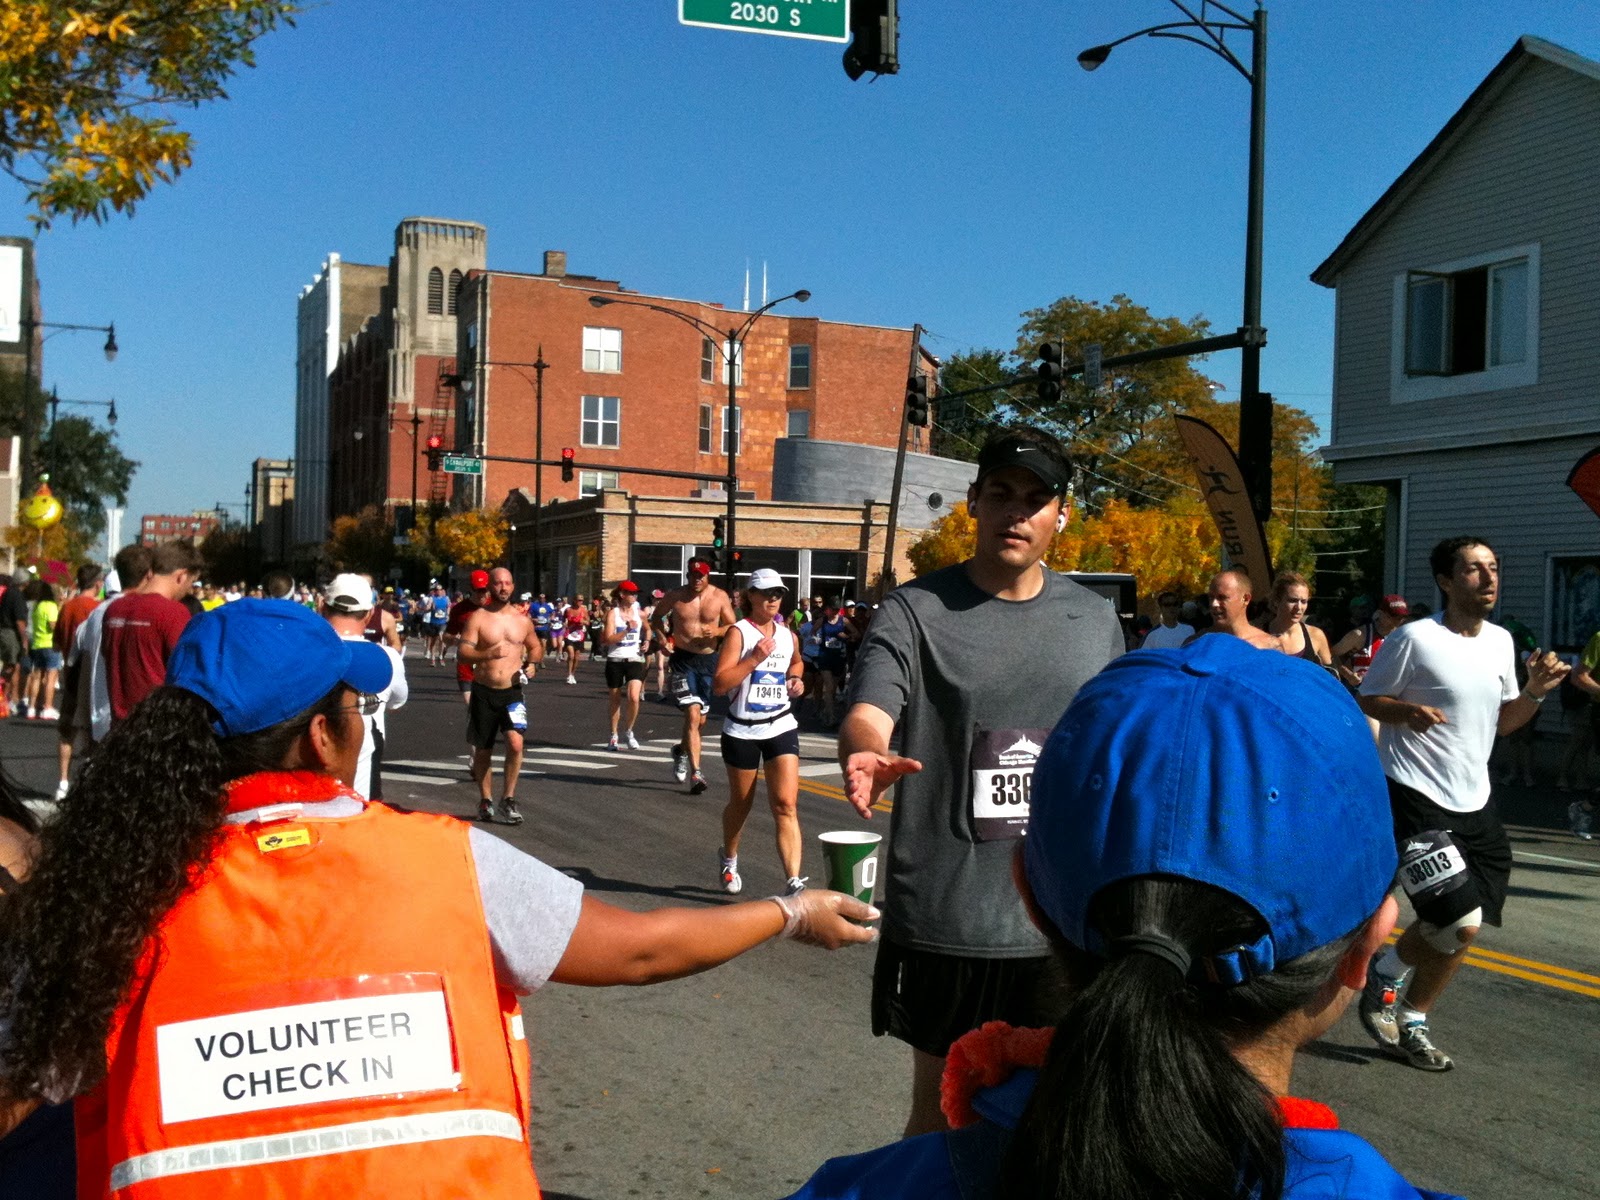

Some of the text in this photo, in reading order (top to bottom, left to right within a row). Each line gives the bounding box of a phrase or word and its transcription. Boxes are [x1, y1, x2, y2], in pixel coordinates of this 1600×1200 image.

[730, 2, 801, 27] 2030 S
[756, 686, 782, 699] 13416
[1406, 852, 1453, 885] 38013
[194, 1012, 411, 1062] VOLUNTEER
[222, 1055, 394, 1100] CHECK IN
